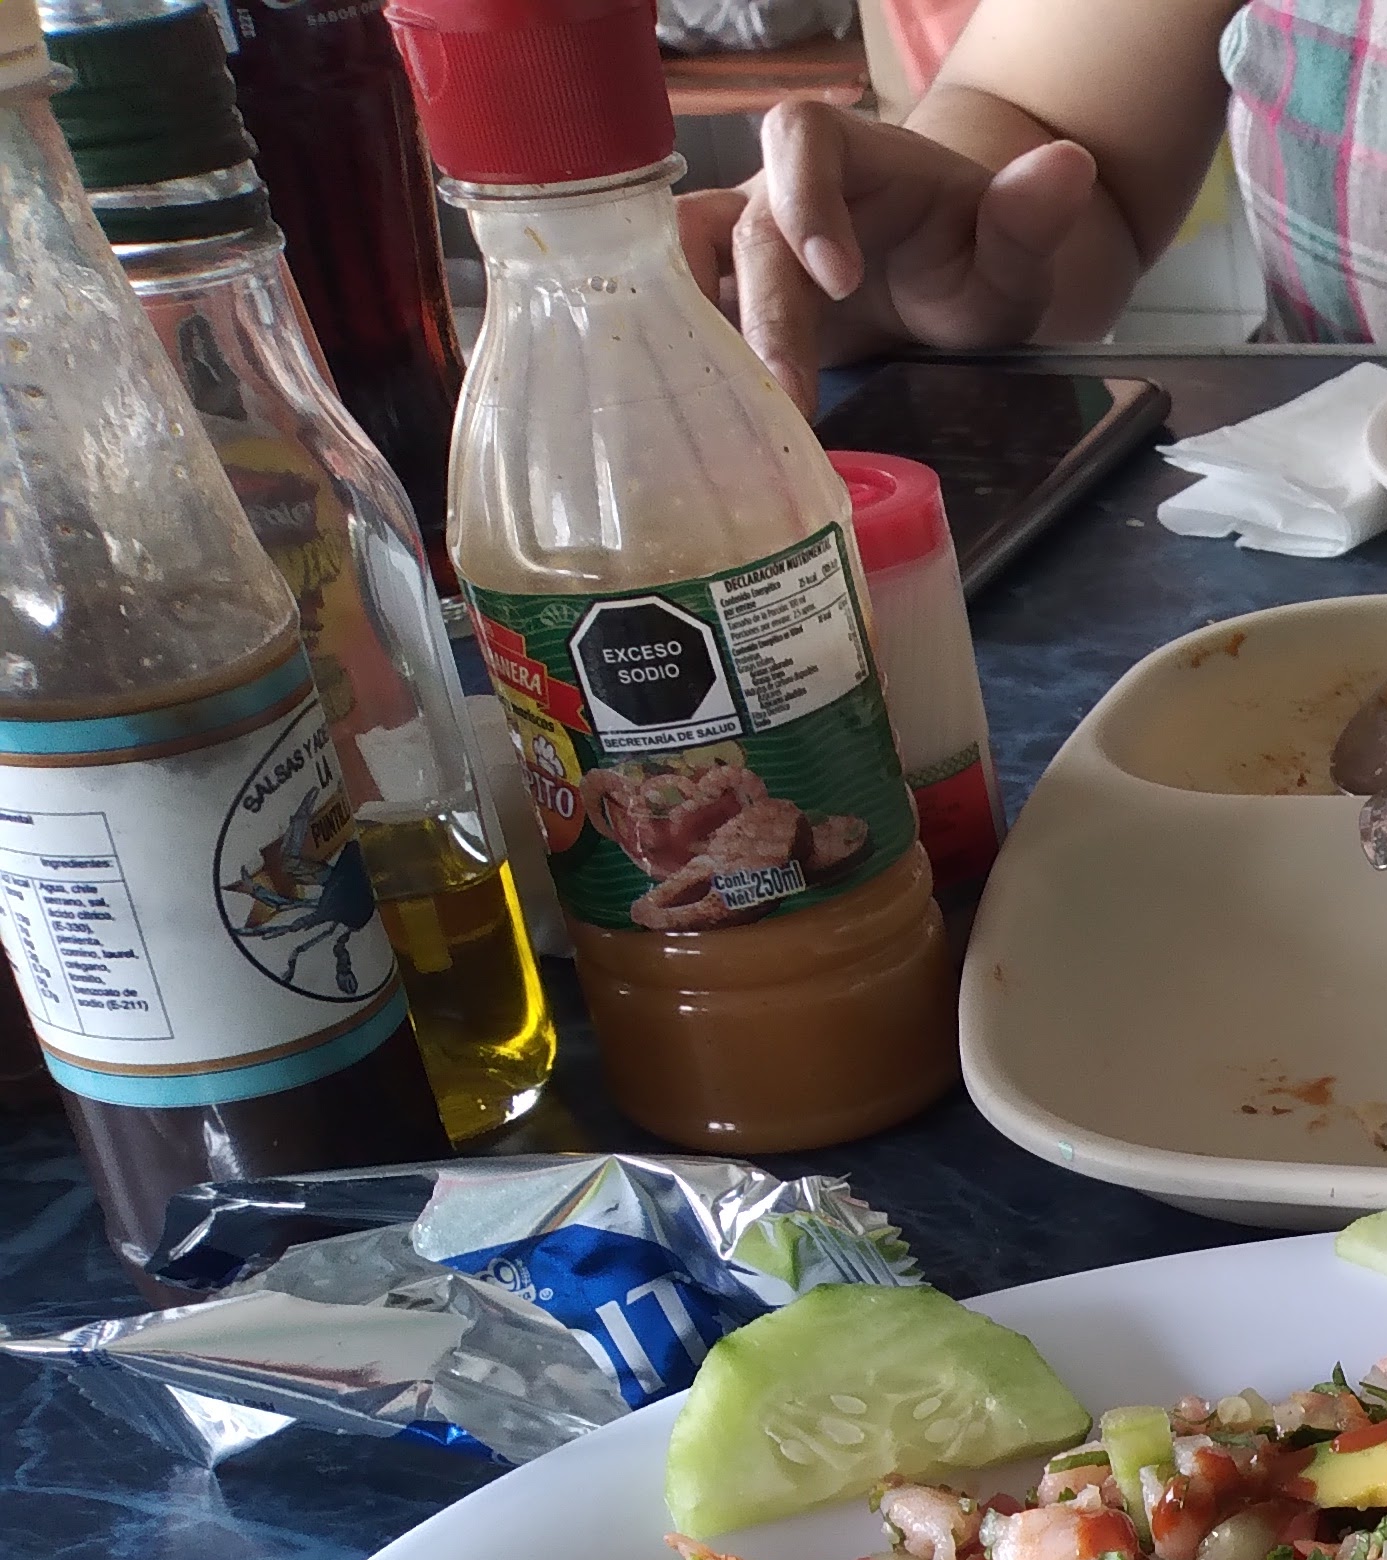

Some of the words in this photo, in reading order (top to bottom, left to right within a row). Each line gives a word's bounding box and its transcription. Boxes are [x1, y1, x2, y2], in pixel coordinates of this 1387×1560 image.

[724, 560, 786, 593] DECLARACIÓN
[602, 640, 683, 663] EXCESO
[617, 663, 680, 684] SODIO
[603, 733, 677, 748] SECRETARÍA
[678, 730, 695, 743] DE
[697, 722, 737, 738] SALUD
[243, 748, 305, 814] SALSAS
[316, 755, 334, 789] LA
[751, 860, 804, 898] 250ml
